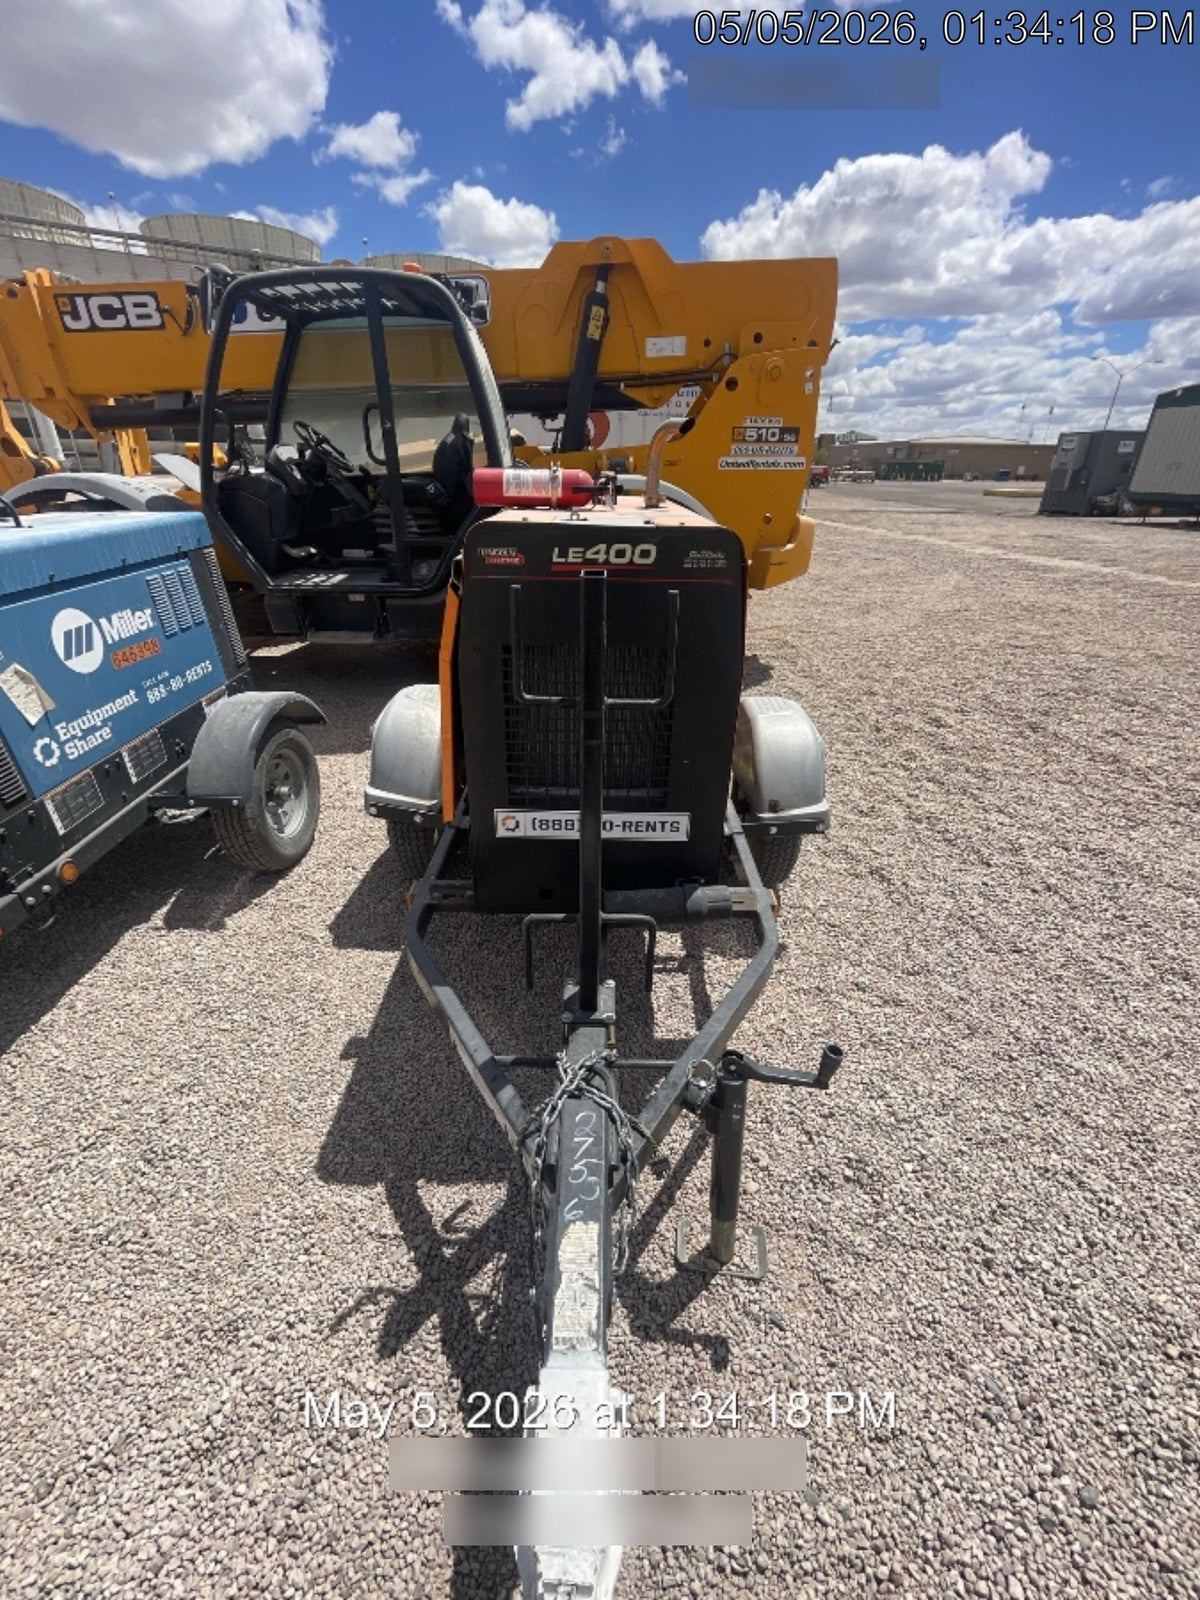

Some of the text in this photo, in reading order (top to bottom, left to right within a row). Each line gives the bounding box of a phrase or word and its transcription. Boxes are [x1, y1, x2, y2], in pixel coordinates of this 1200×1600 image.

[64, 293, 163, 331] JCB
[552, 543, 657, 565] LE400
[100, 607, 153, 644] Miller
[55, 690, 139, 742] Equipment
[64, 726, 112, 760] Share
